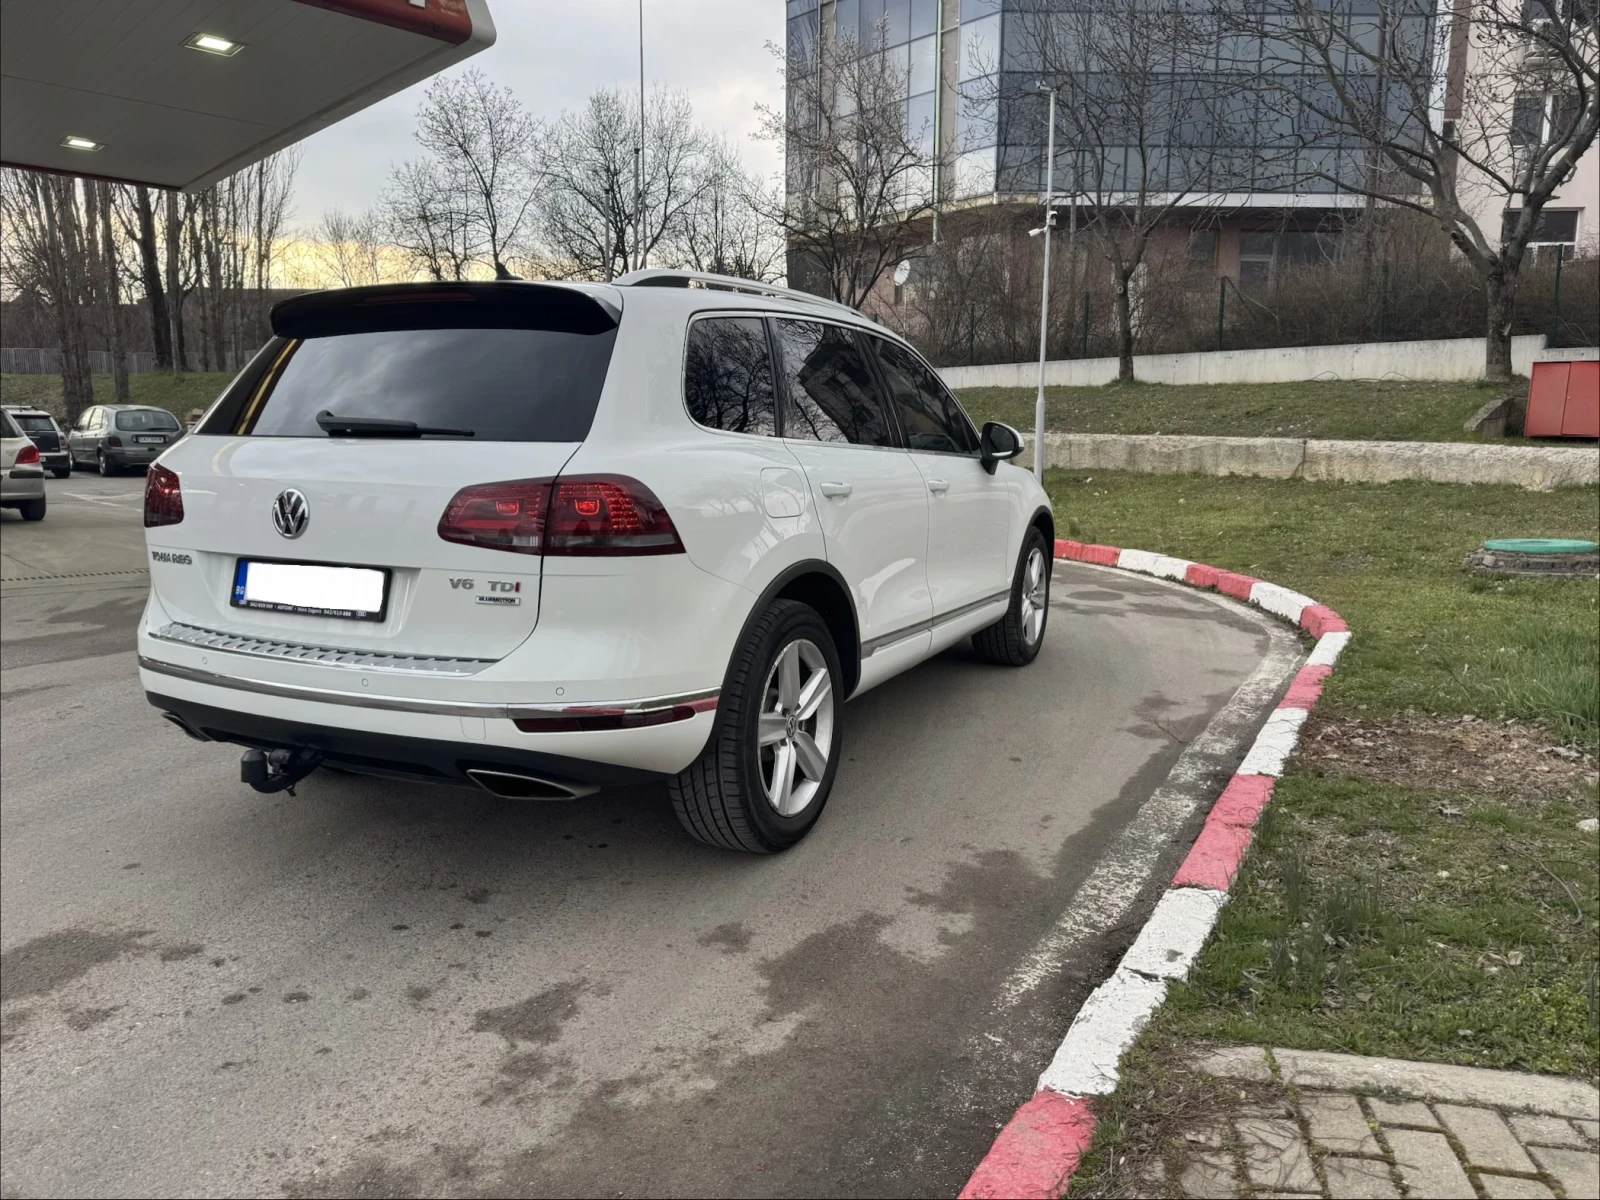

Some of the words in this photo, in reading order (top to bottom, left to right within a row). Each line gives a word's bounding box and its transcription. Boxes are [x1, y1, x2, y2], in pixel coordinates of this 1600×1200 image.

[235, 585, 245, 595] BG
[448, 577, 475, 590] V6
[487, 580, 522, 593] TDI
